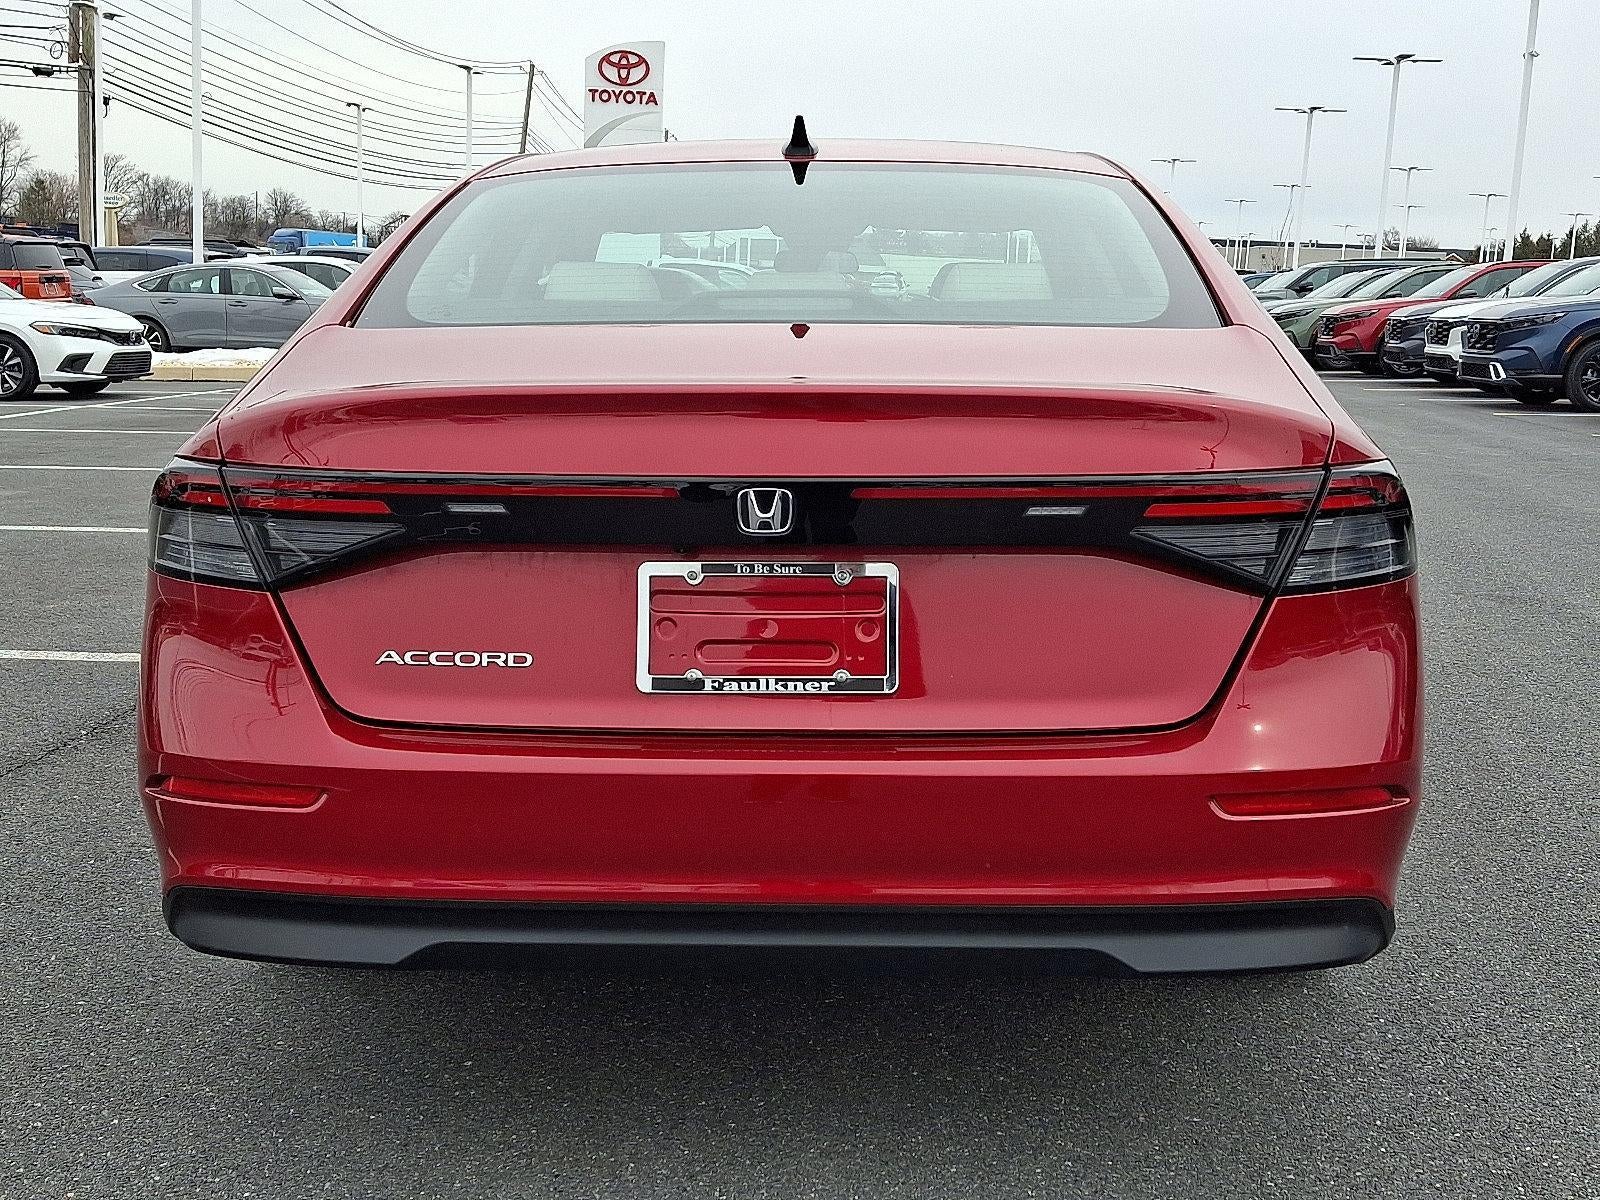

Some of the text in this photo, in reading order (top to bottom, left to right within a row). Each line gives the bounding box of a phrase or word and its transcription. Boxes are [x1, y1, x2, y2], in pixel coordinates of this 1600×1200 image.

[588, 88, 658, 105] TOYOTA
[734, 563, 803, 574] To Be Sure
[375, 650, 534, 667] ACCORD
[701, 678, 836, 691] Faulkner
